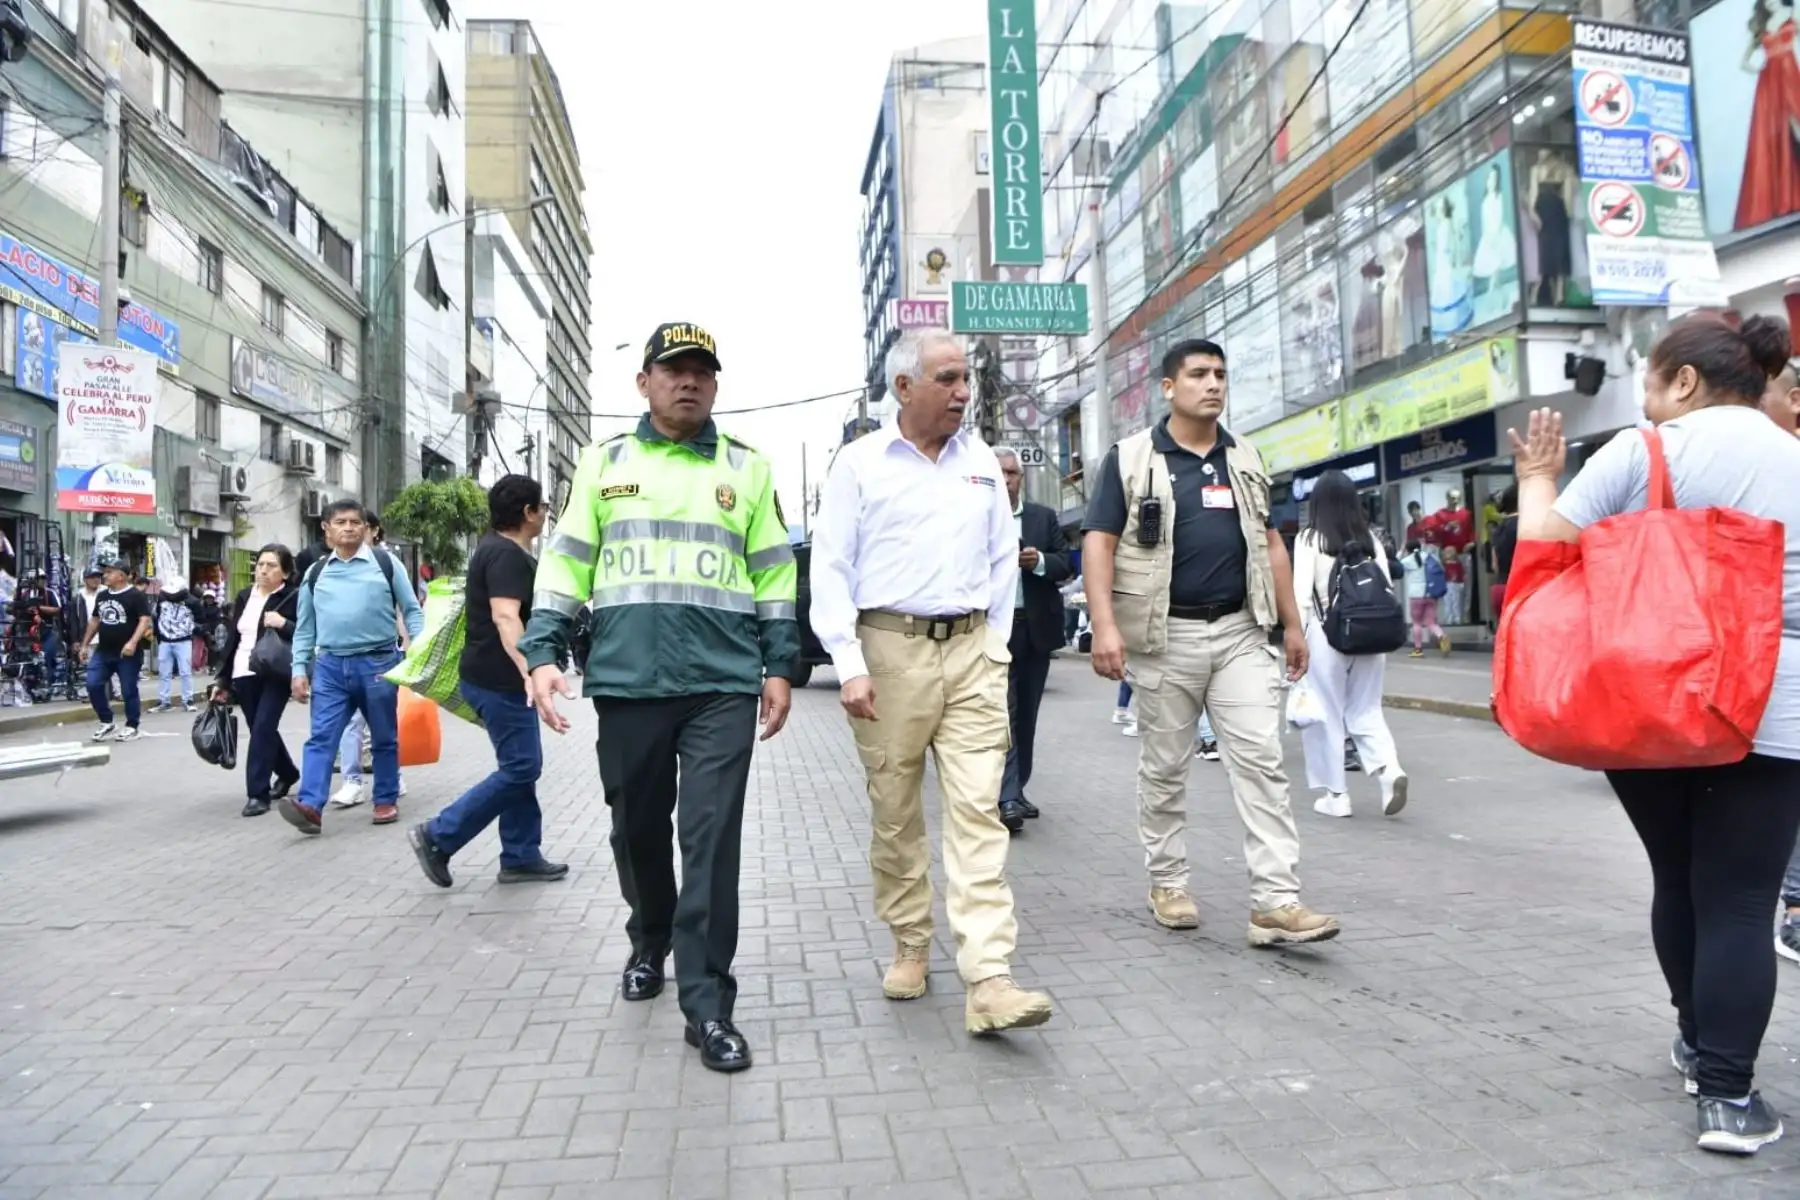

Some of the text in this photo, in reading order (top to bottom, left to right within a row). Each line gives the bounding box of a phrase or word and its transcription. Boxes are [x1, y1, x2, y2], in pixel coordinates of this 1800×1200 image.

[1000, 8, 1023, 75] LA
[1575, 23, 1686, 61] RECUPEREMOS
[1000, 89, 1031, 250] TORRE
[965, 285, 1076, 312] DE GAMARRA
[899, 303, 949, 325] GALE
[986, 317, 1043, 328] UNANUE
[662, 324, 715, 353] POLICIA
[84, 381, 132, 392] PASACALLE
[96, 375, 121, 384] GRAN
[62, 387, 110, 399] CELEBRA
[112, 392, 124, 401] AL
[78, 405, 136, 418] GAMARRA
[602, 545, 739, 587] POLICIA
